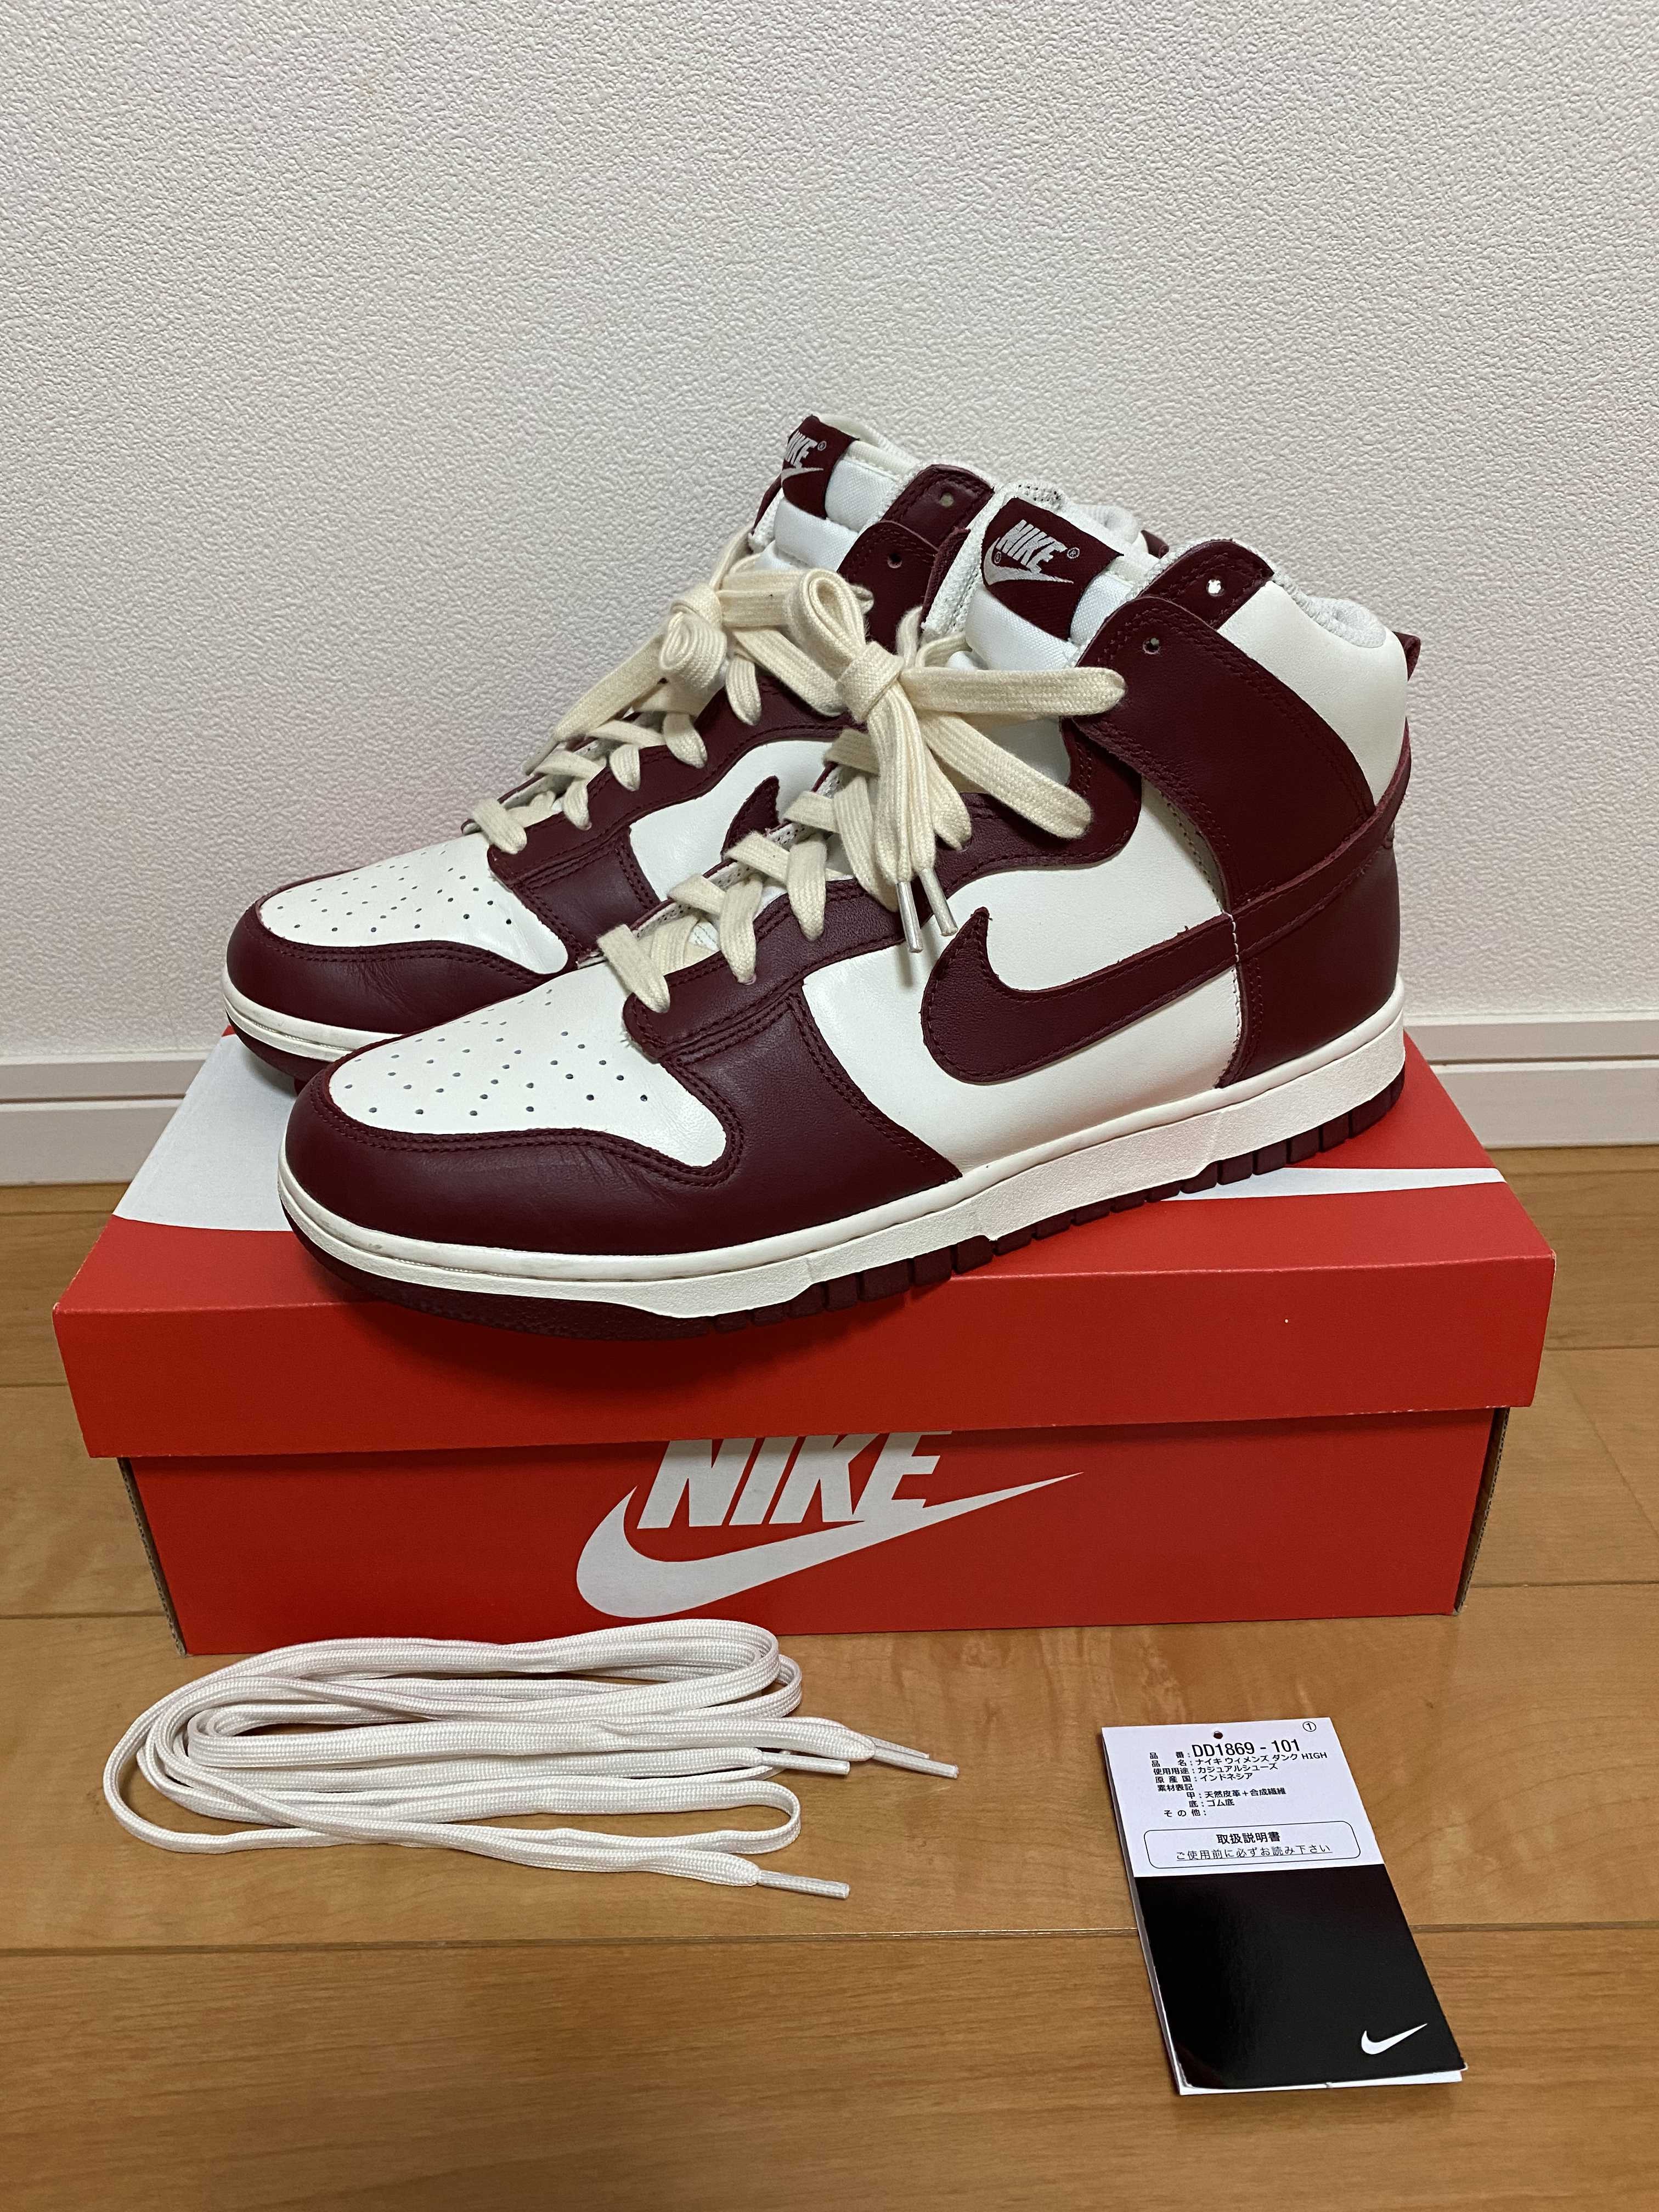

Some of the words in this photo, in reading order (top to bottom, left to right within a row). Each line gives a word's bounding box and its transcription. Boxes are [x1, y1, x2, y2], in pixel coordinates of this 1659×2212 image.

[996, 519, 1068, 573] NIKE
[637, 1430, 952, 1529] NIKE
[1192, 1741, 1255, 1757] DD1869
[1271, 1739, 1300, 1753] 101
[1272, 1753, 1298, 1762] ダンク
[1158, 1784, 1194, 1792] 素材表記
[1216, 1831, 1280, 1844] 取扱説明書
[1177, 1844, 1330, 1860] ご使用前に必ずお読み下さい
